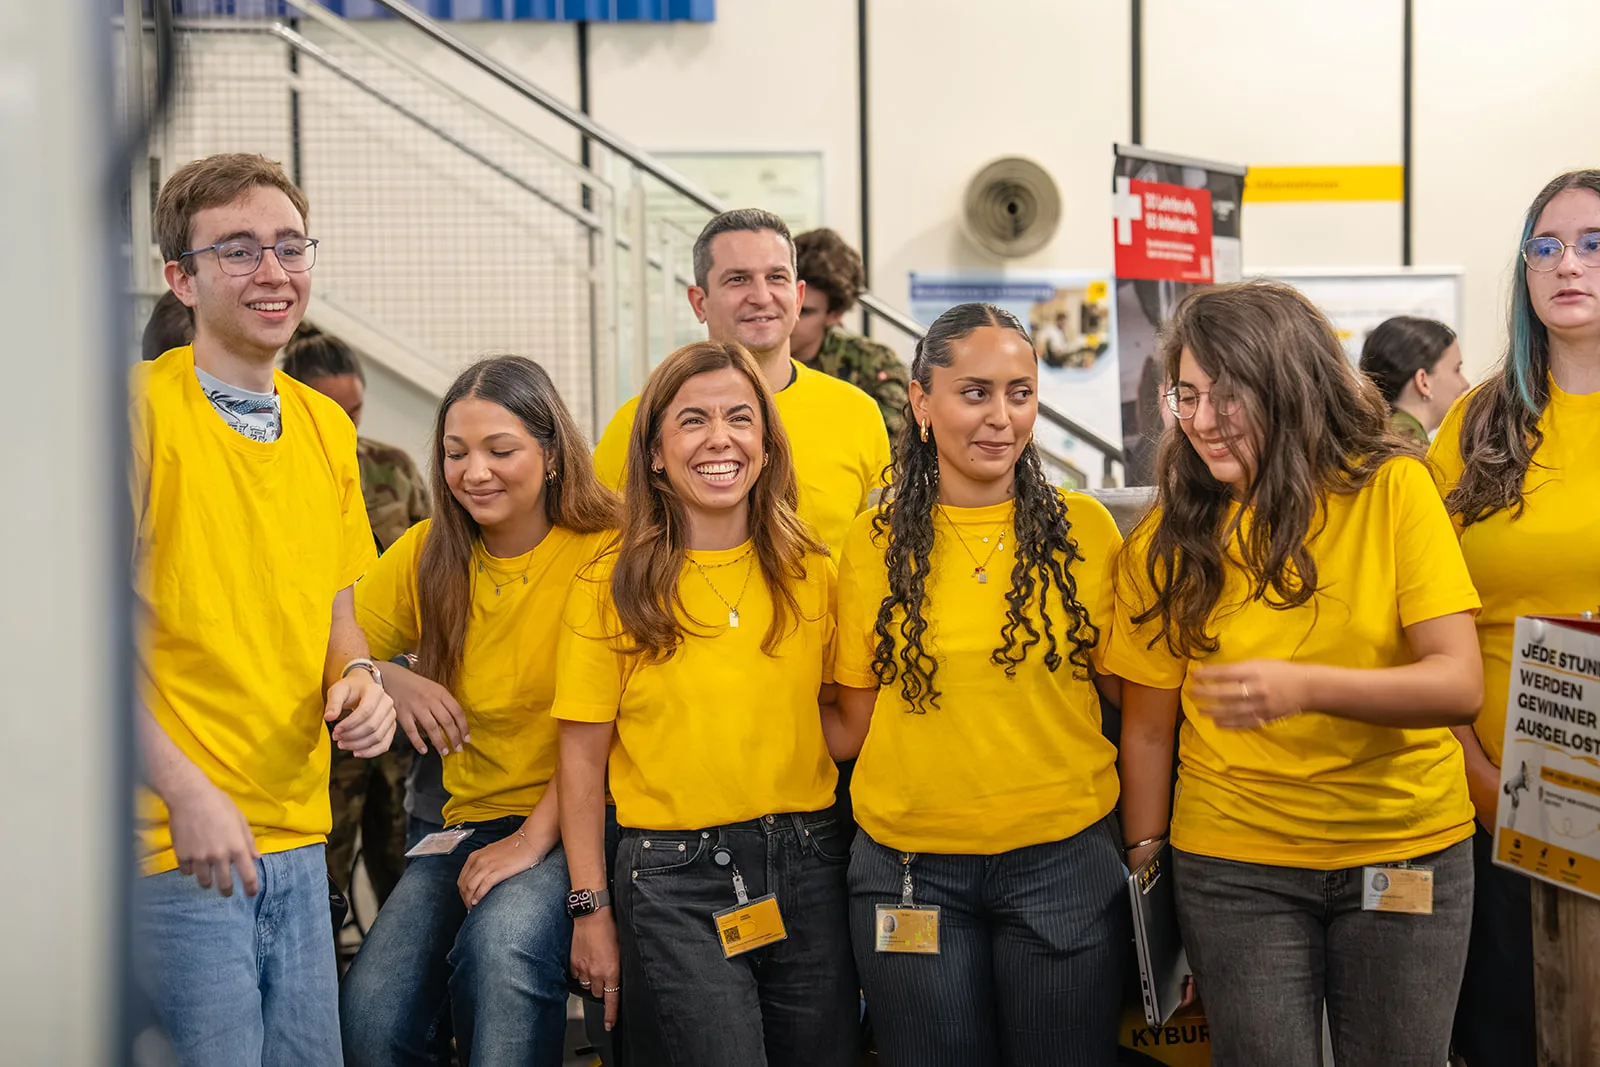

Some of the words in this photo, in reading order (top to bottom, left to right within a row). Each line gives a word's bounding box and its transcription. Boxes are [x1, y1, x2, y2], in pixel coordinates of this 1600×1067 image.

[1521, 643, 1557, 666] JEDE
[1559, 652, 1600, 678] STUN
[1520, 668, 1583, 701] WERDEN
[1518, 692, 1597, 730] GEWINNER
[1515, 717, 1600, 756] AUSGELOST
[568, 894, 580, 910] 10
